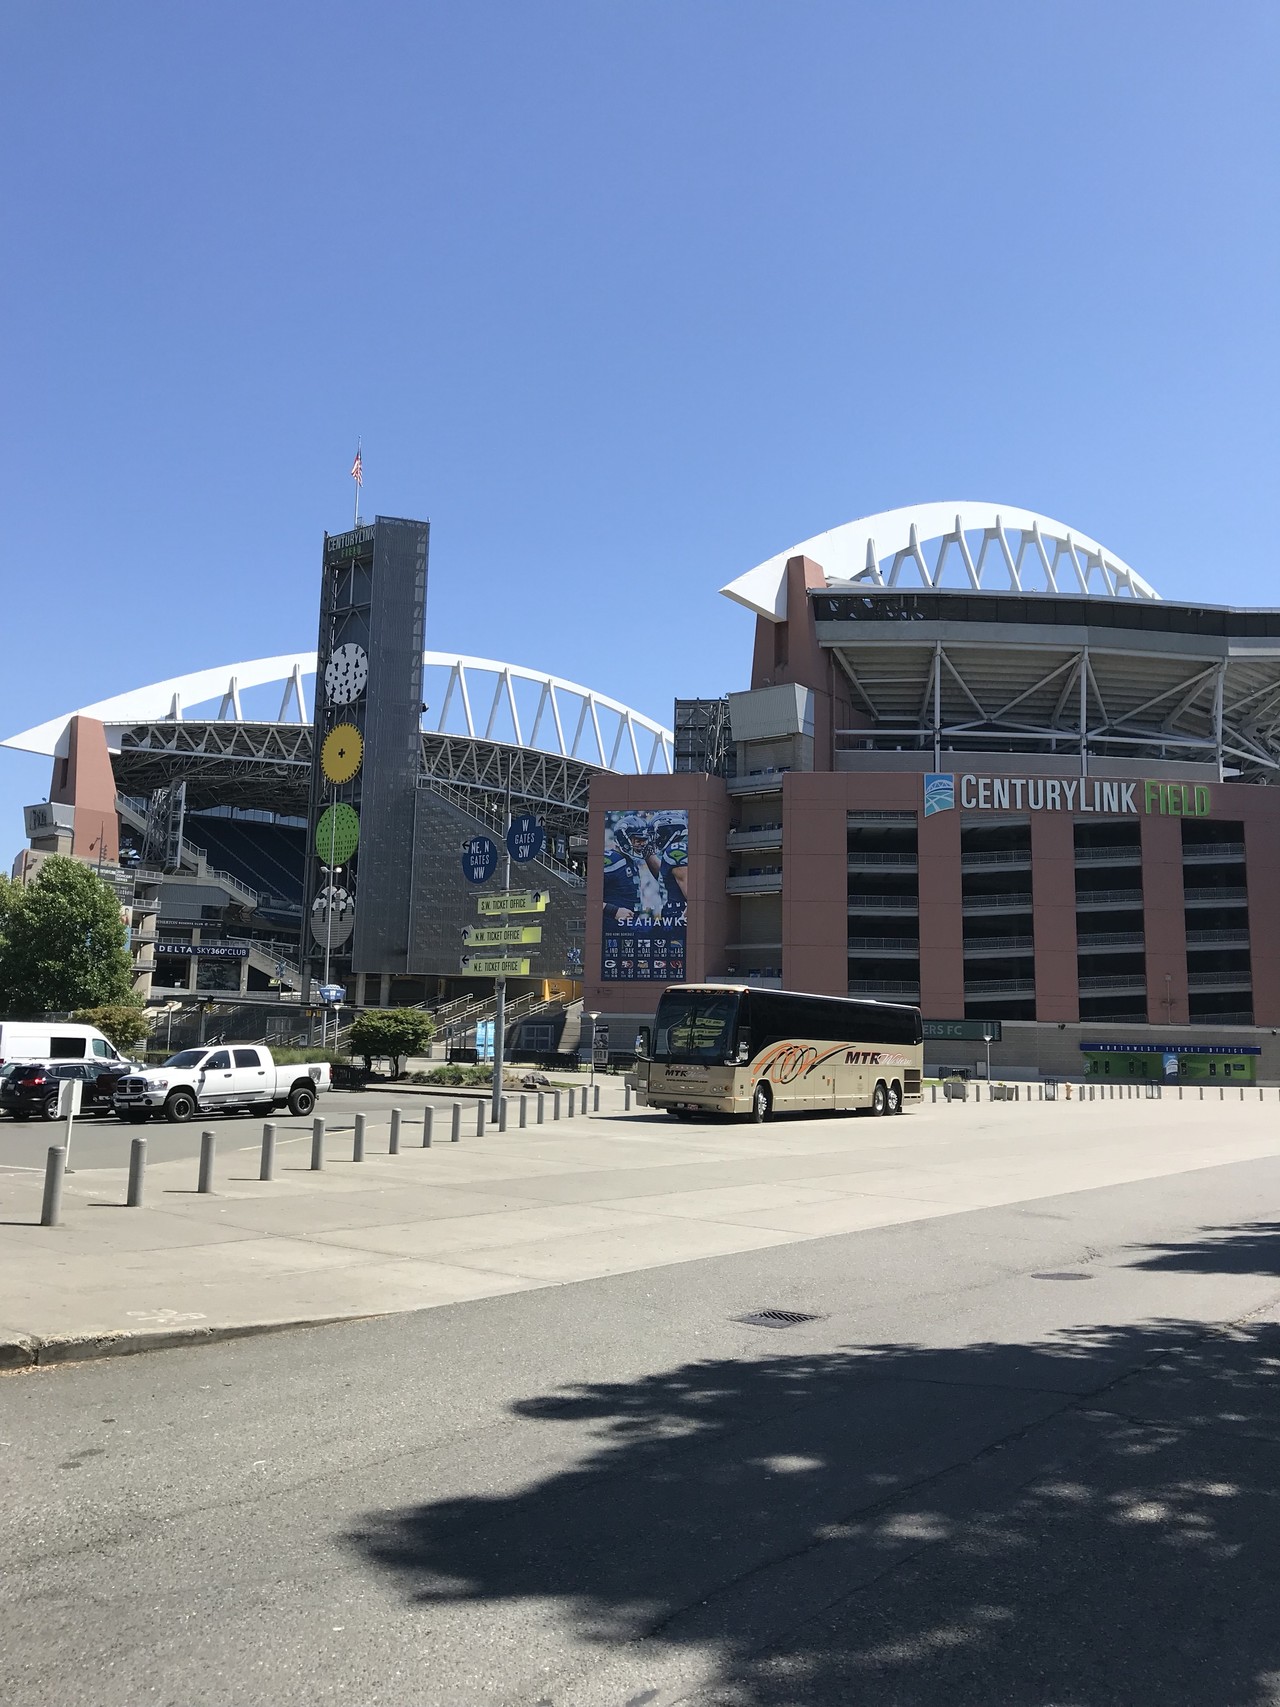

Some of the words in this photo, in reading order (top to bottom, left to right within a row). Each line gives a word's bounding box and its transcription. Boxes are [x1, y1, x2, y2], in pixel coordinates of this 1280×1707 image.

[327, 527, 375, 552] CENTURYLINK
[341, 545, 361, 558] FIELD
[960, 774, 1138, 814] CENTURYLINK
[1144, 779, 1211, 817] FIELD
[522, 819, 529, 832] W
[514, 832, 535, 845] GATES
[471, 841, 482, 854] NE,
[484, 840, 490, 853] N
[518, 845, 530, 858] SW
[470, 854, 490, 866] GATES
[473, 866, 485, 879] NW
[493, 900, 508, 910] TICKET
[510, 899, 526, 909] OFFICE
[487, 931, 502, 941] TICKET
[504, 930, 520, 940] OFFICE
[158, 945, 193, 954] DELTA
[485, 962, 500, 972] TICKET
[501, 961, 518, 971] OFFICE
[947, 1025, 963, 1036] FC
